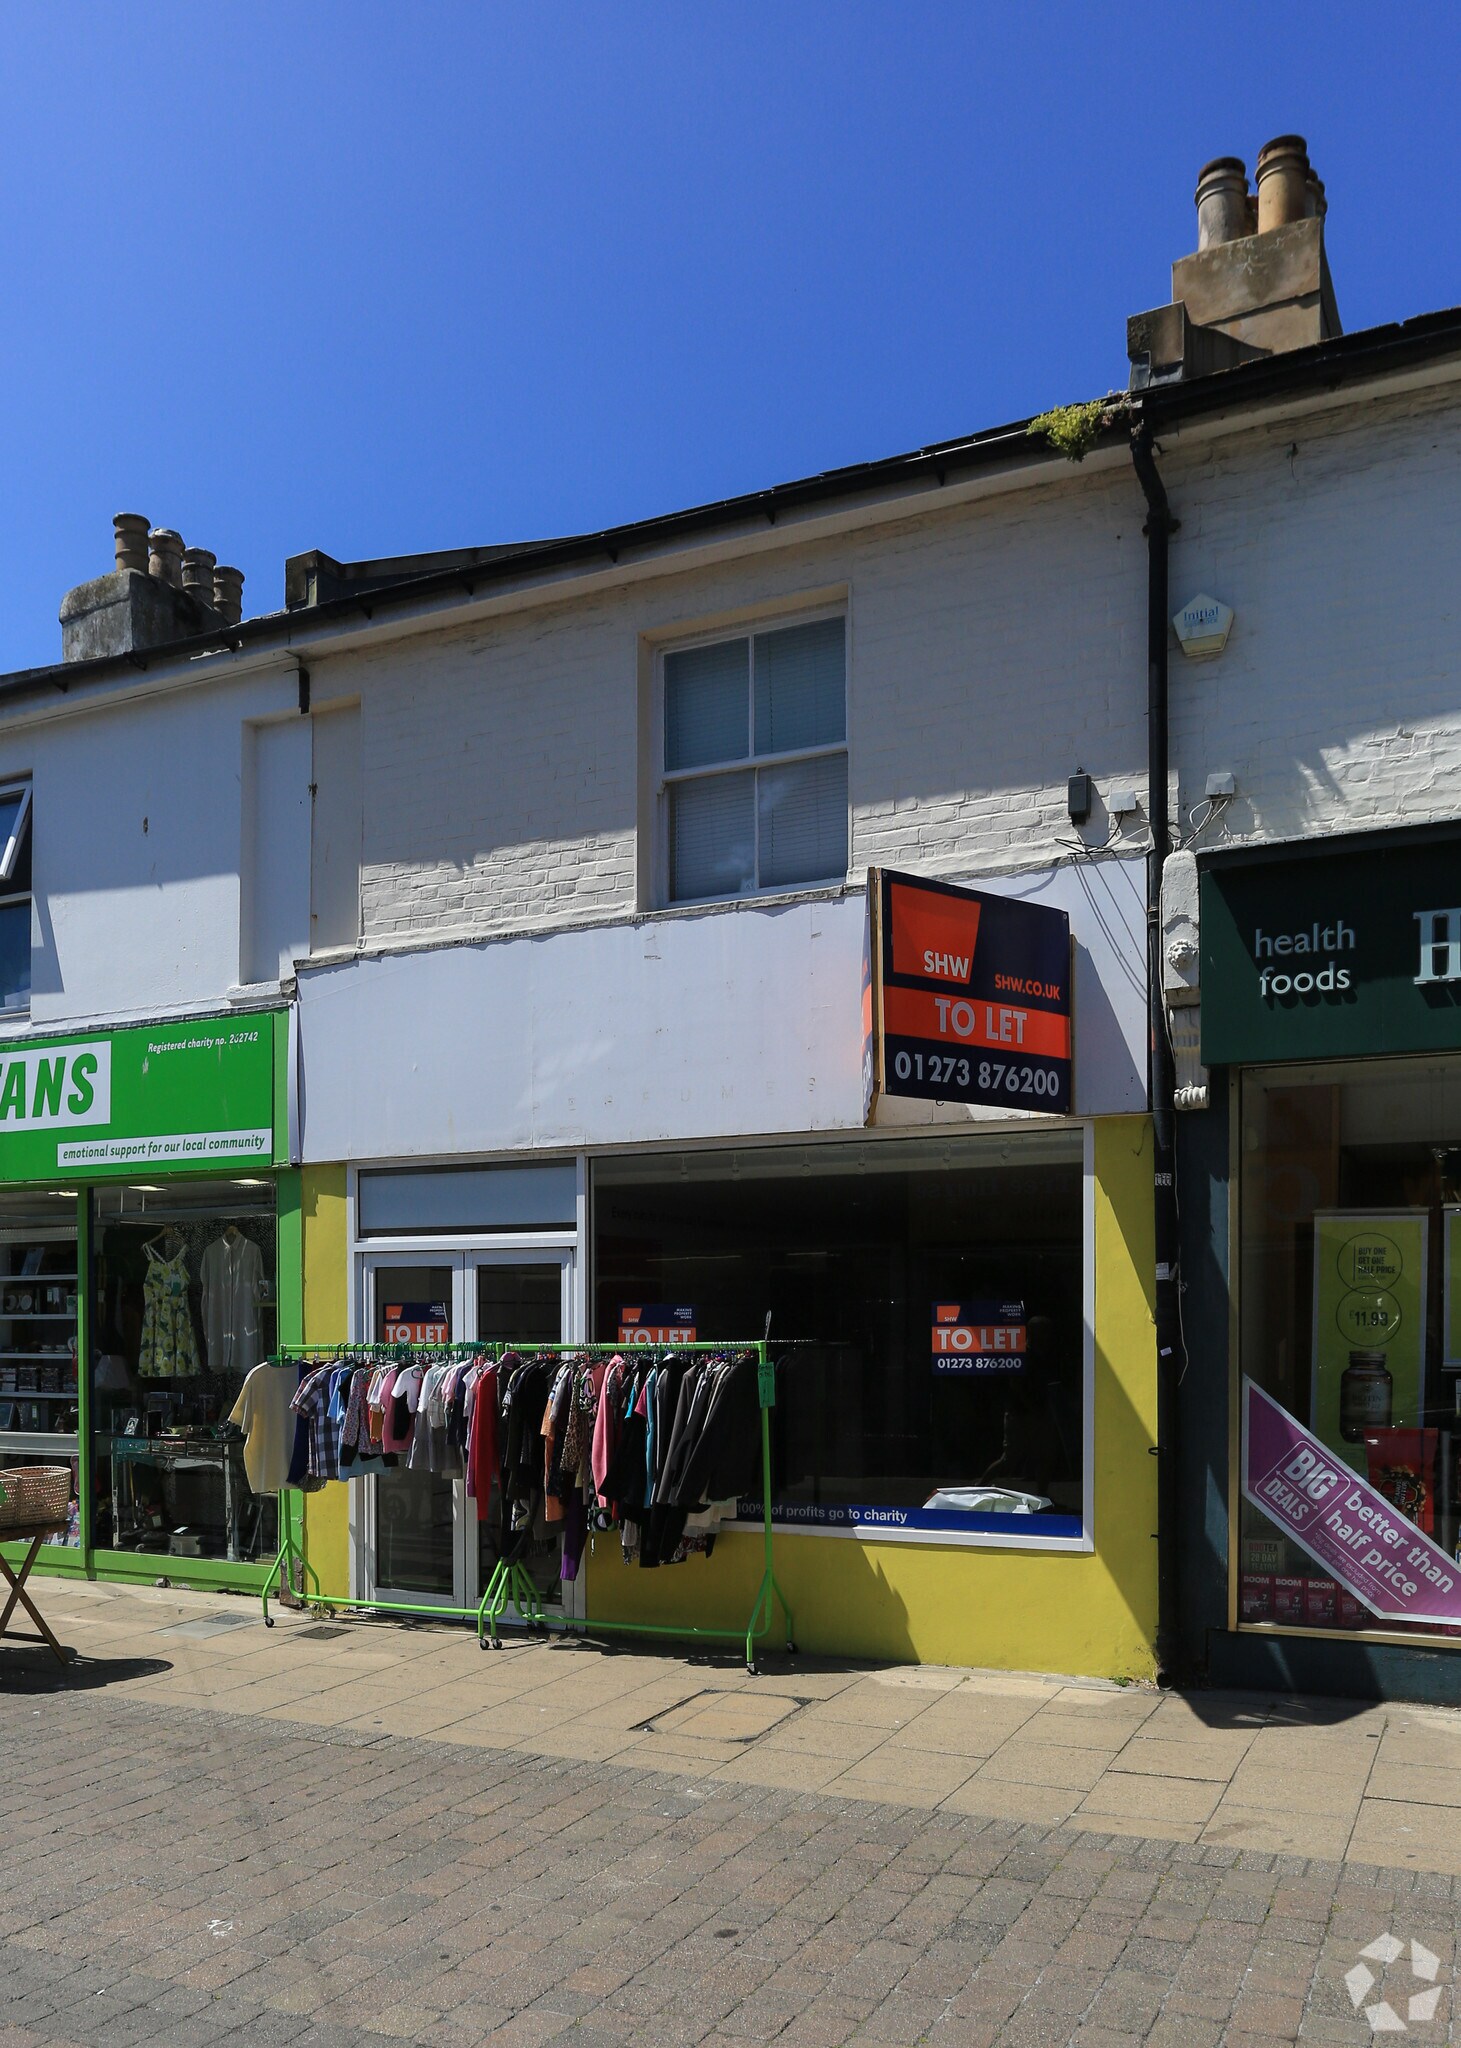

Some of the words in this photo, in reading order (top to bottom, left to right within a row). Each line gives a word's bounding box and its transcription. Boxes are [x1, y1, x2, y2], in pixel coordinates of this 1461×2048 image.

[1184, 606, 1219, 621] Initial
[1255, 920, 1356, 958] health
[923, 950, 969, 979] SHW
[995, 974, 1061, 1001] SHW.CO.UK
[1259, 962, 1351, 998] foods
[935, 998, 976, 1037] TO
[986, 1006, 1028, 1044] LET
[148, 1039, 186, 1054] Registered
[187, 1037, 213, 1049] charity
[215, 1037, 226, 1045] no.
[0, 1053, 98, 1120] ANS
[895, 1051, 970, 1086] 01273
[978, 1062, 1059, 1097] 876200
[63, 1144, 109, 1159] emotional
[110, 1142, 146, 1159] support
[147, 1141, 162, 1157] for
[164, 1143, 181, 1153] our
[182, 1137, 206, 1152] local
[209, 1134, 265, 1150] community
[1358, 1247, 1372, 1255] BUY
[386, 1325, 411, 1343] TO
[416, 1325, 445, 1343] LET
[622, 1329, 652, 1343] TO
[937, 1328, 973, 1350] TO
[980, 1328, 1021, 1350] LET
[937, 1358, 973, 1369] 01273
[975, 1358, 1022, 1369] 876200
[1283, 1448, 1338, 1500] BIG
[1263, 1477, 1309, 1521] DEALS
[771, 1505, 784, 1515] of
[786, 1506, 825, 1518] profits
[828, 1509, 844, 1520] go
[848, 1508, 860, 1520] to
[863, 1508, 908, 1524] charity
[1325, 1509, 1372, 1550] half
[1361, 1548, 1418, 1597] price
[1344, 1490, 1409, 1550] better
[1406, 1545, 1455, 1594] than
[1244, 1575, 1269, 1584] BOOM
[1276, 1578, 1302, 1587] BOOM
[1308, 1581, 1335, 1590] BOOM
